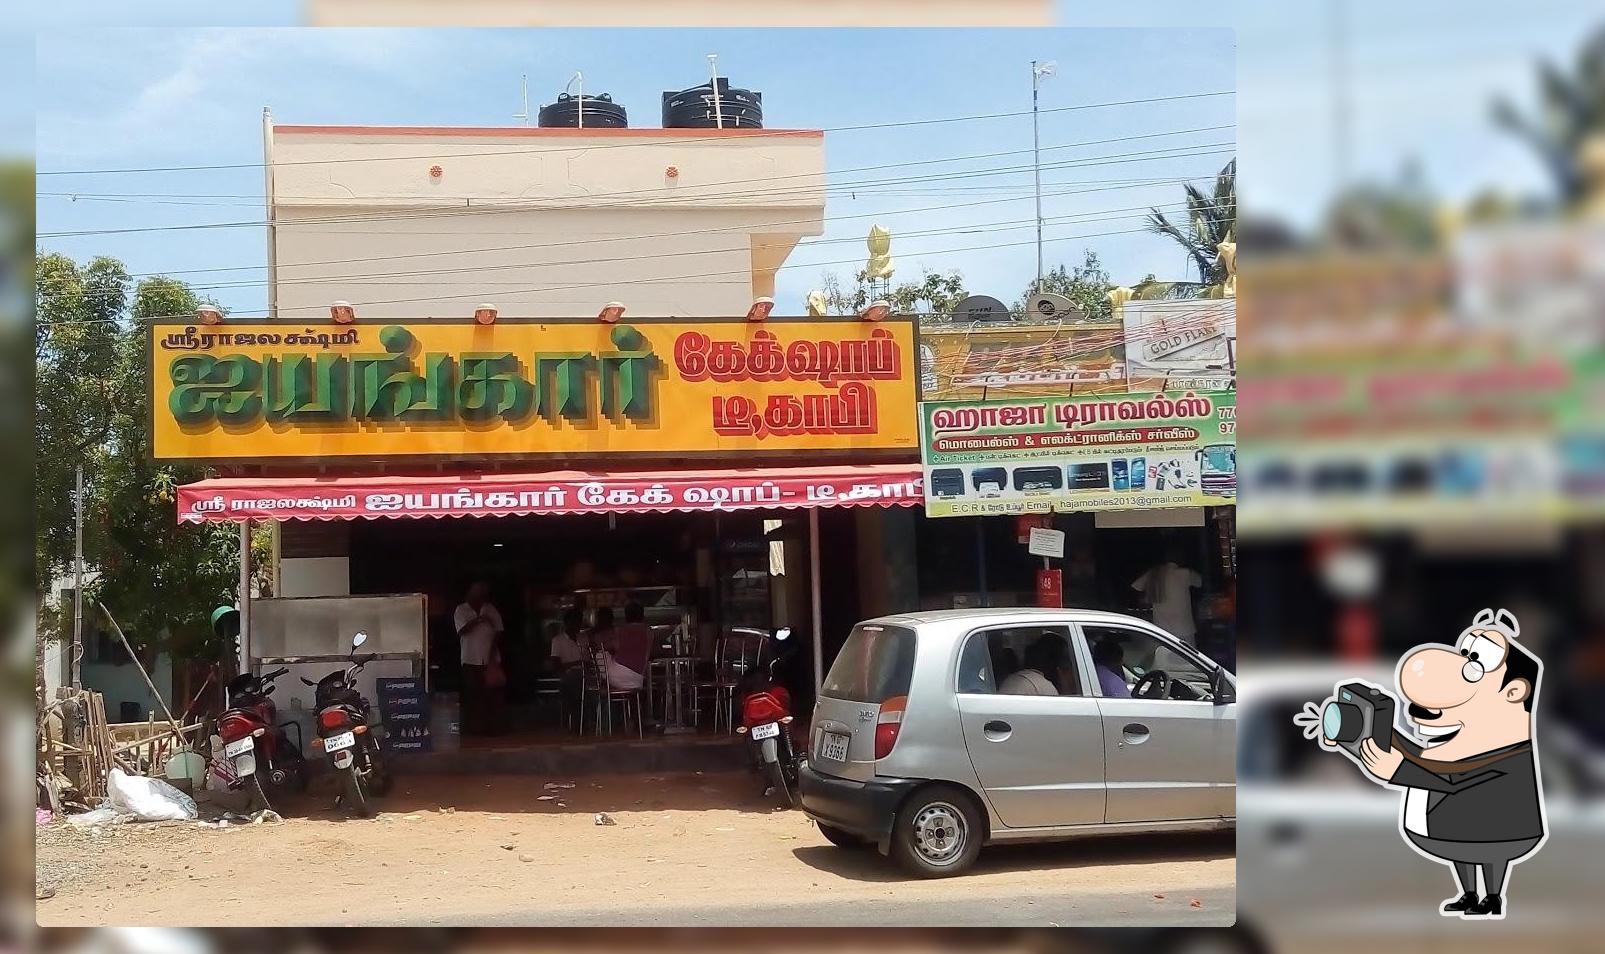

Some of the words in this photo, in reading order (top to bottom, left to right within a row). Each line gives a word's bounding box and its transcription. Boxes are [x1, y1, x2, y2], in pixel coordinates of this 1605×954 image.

[1151, 336, 1182, 354] GOLD
[168, 325, 664, 432] ஐயங்கார்
[933, 402, 1047, 437] ஹாஜா
[1054, 391, 1212, 429] டிராவல்ஸ்
[939, 436, 1019, 450] மொபைல்ஸ்
[1024, 435, 1035, 446] &
[1040, 430, 1142, 446] எலக்ட்ரானிக்ஸ்
[1147, 427, 1195, 440] சர்வீஸ்
[191, 495, 226, 513] ஸ்ரீ
[365, 486, 568, 511] ஐயங்கார்
[577, 481, 674, 506] கேக்
[1060, 495, 1192, 509] hajamobiles2013@gmail.com
